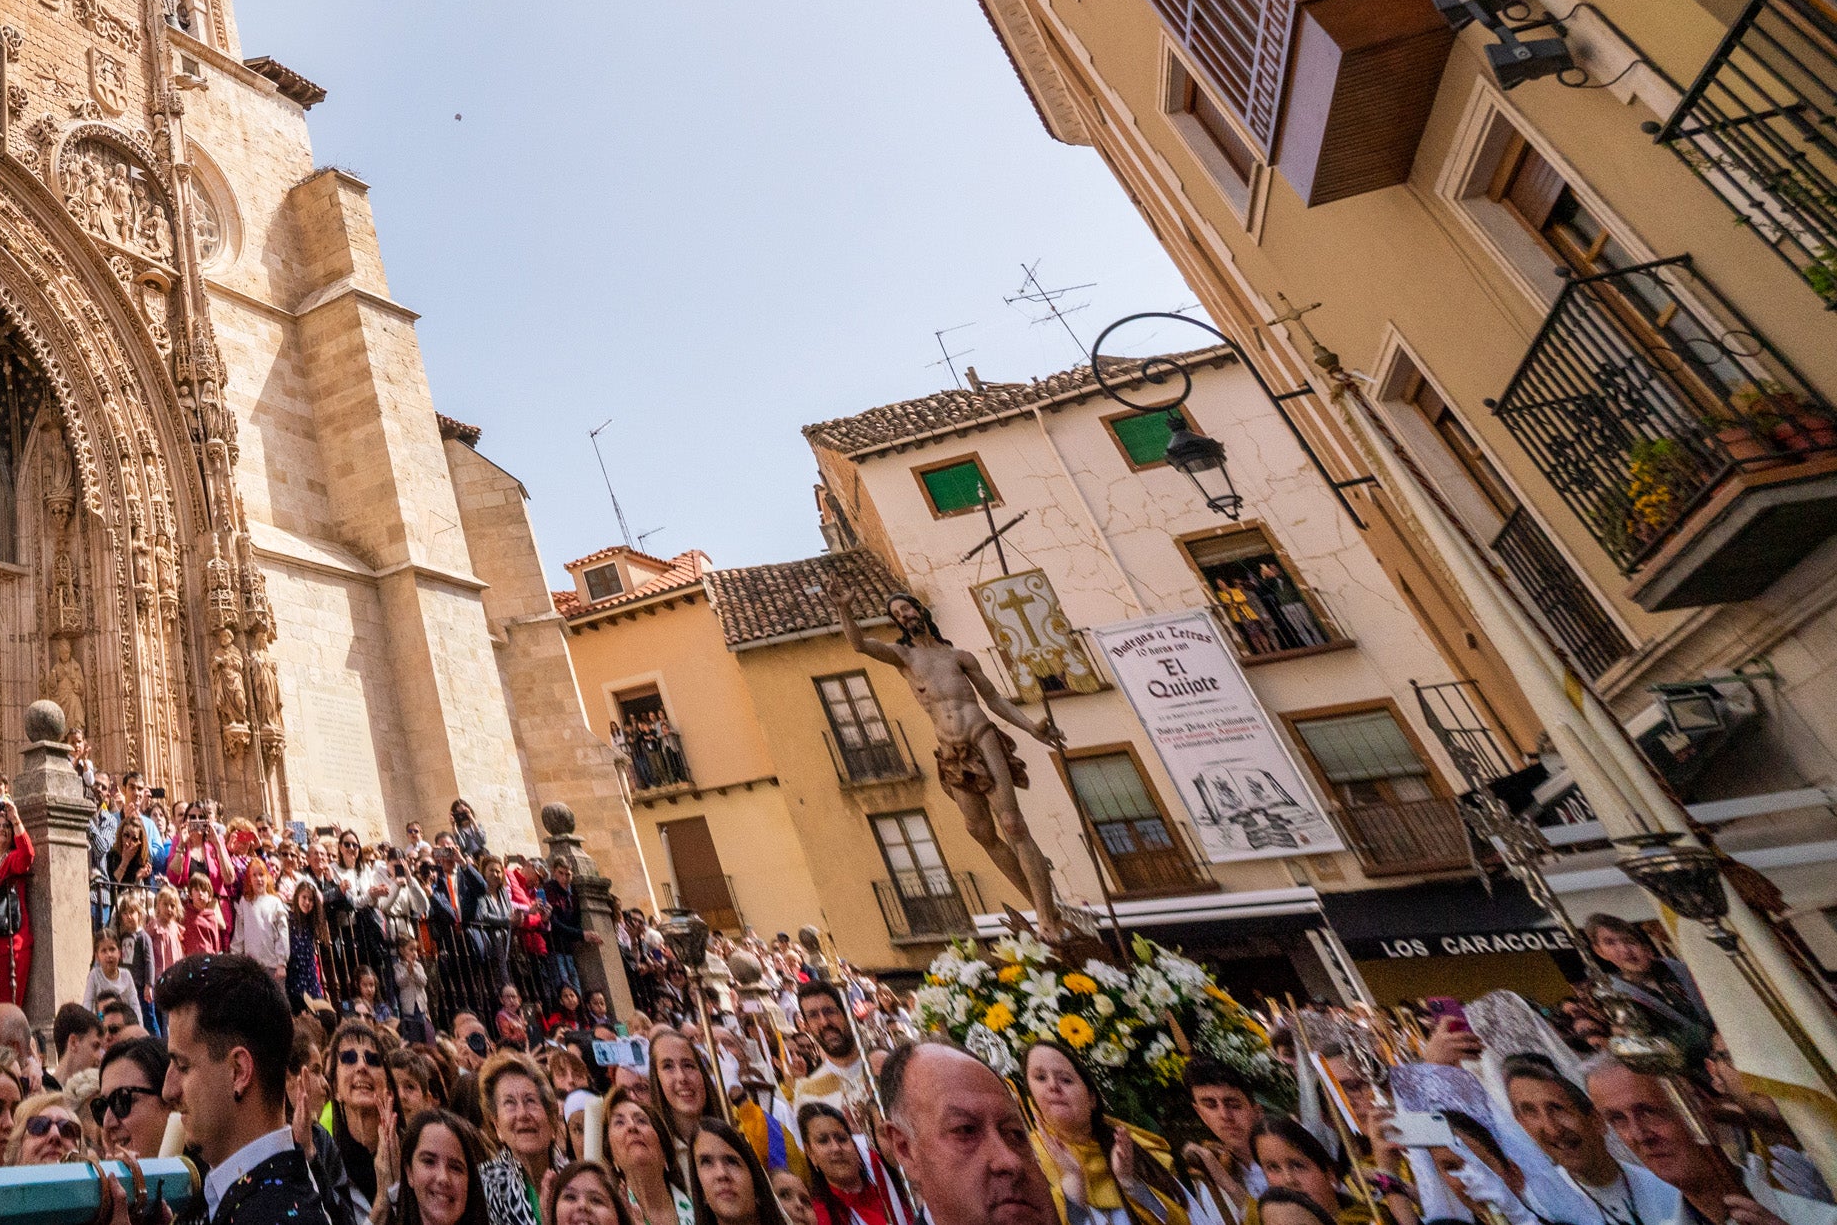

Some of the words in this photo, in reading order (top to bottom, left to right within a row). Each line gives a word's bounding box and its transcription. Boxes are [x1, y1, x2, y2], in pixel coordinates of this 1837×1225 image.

[1157, 658, 1188, 677] El
[1147, 676, 1220, 699] Quijote
[1380, 938, 1430, 959] LOS
[1440, 930, 1575, 955] CARACOLE
